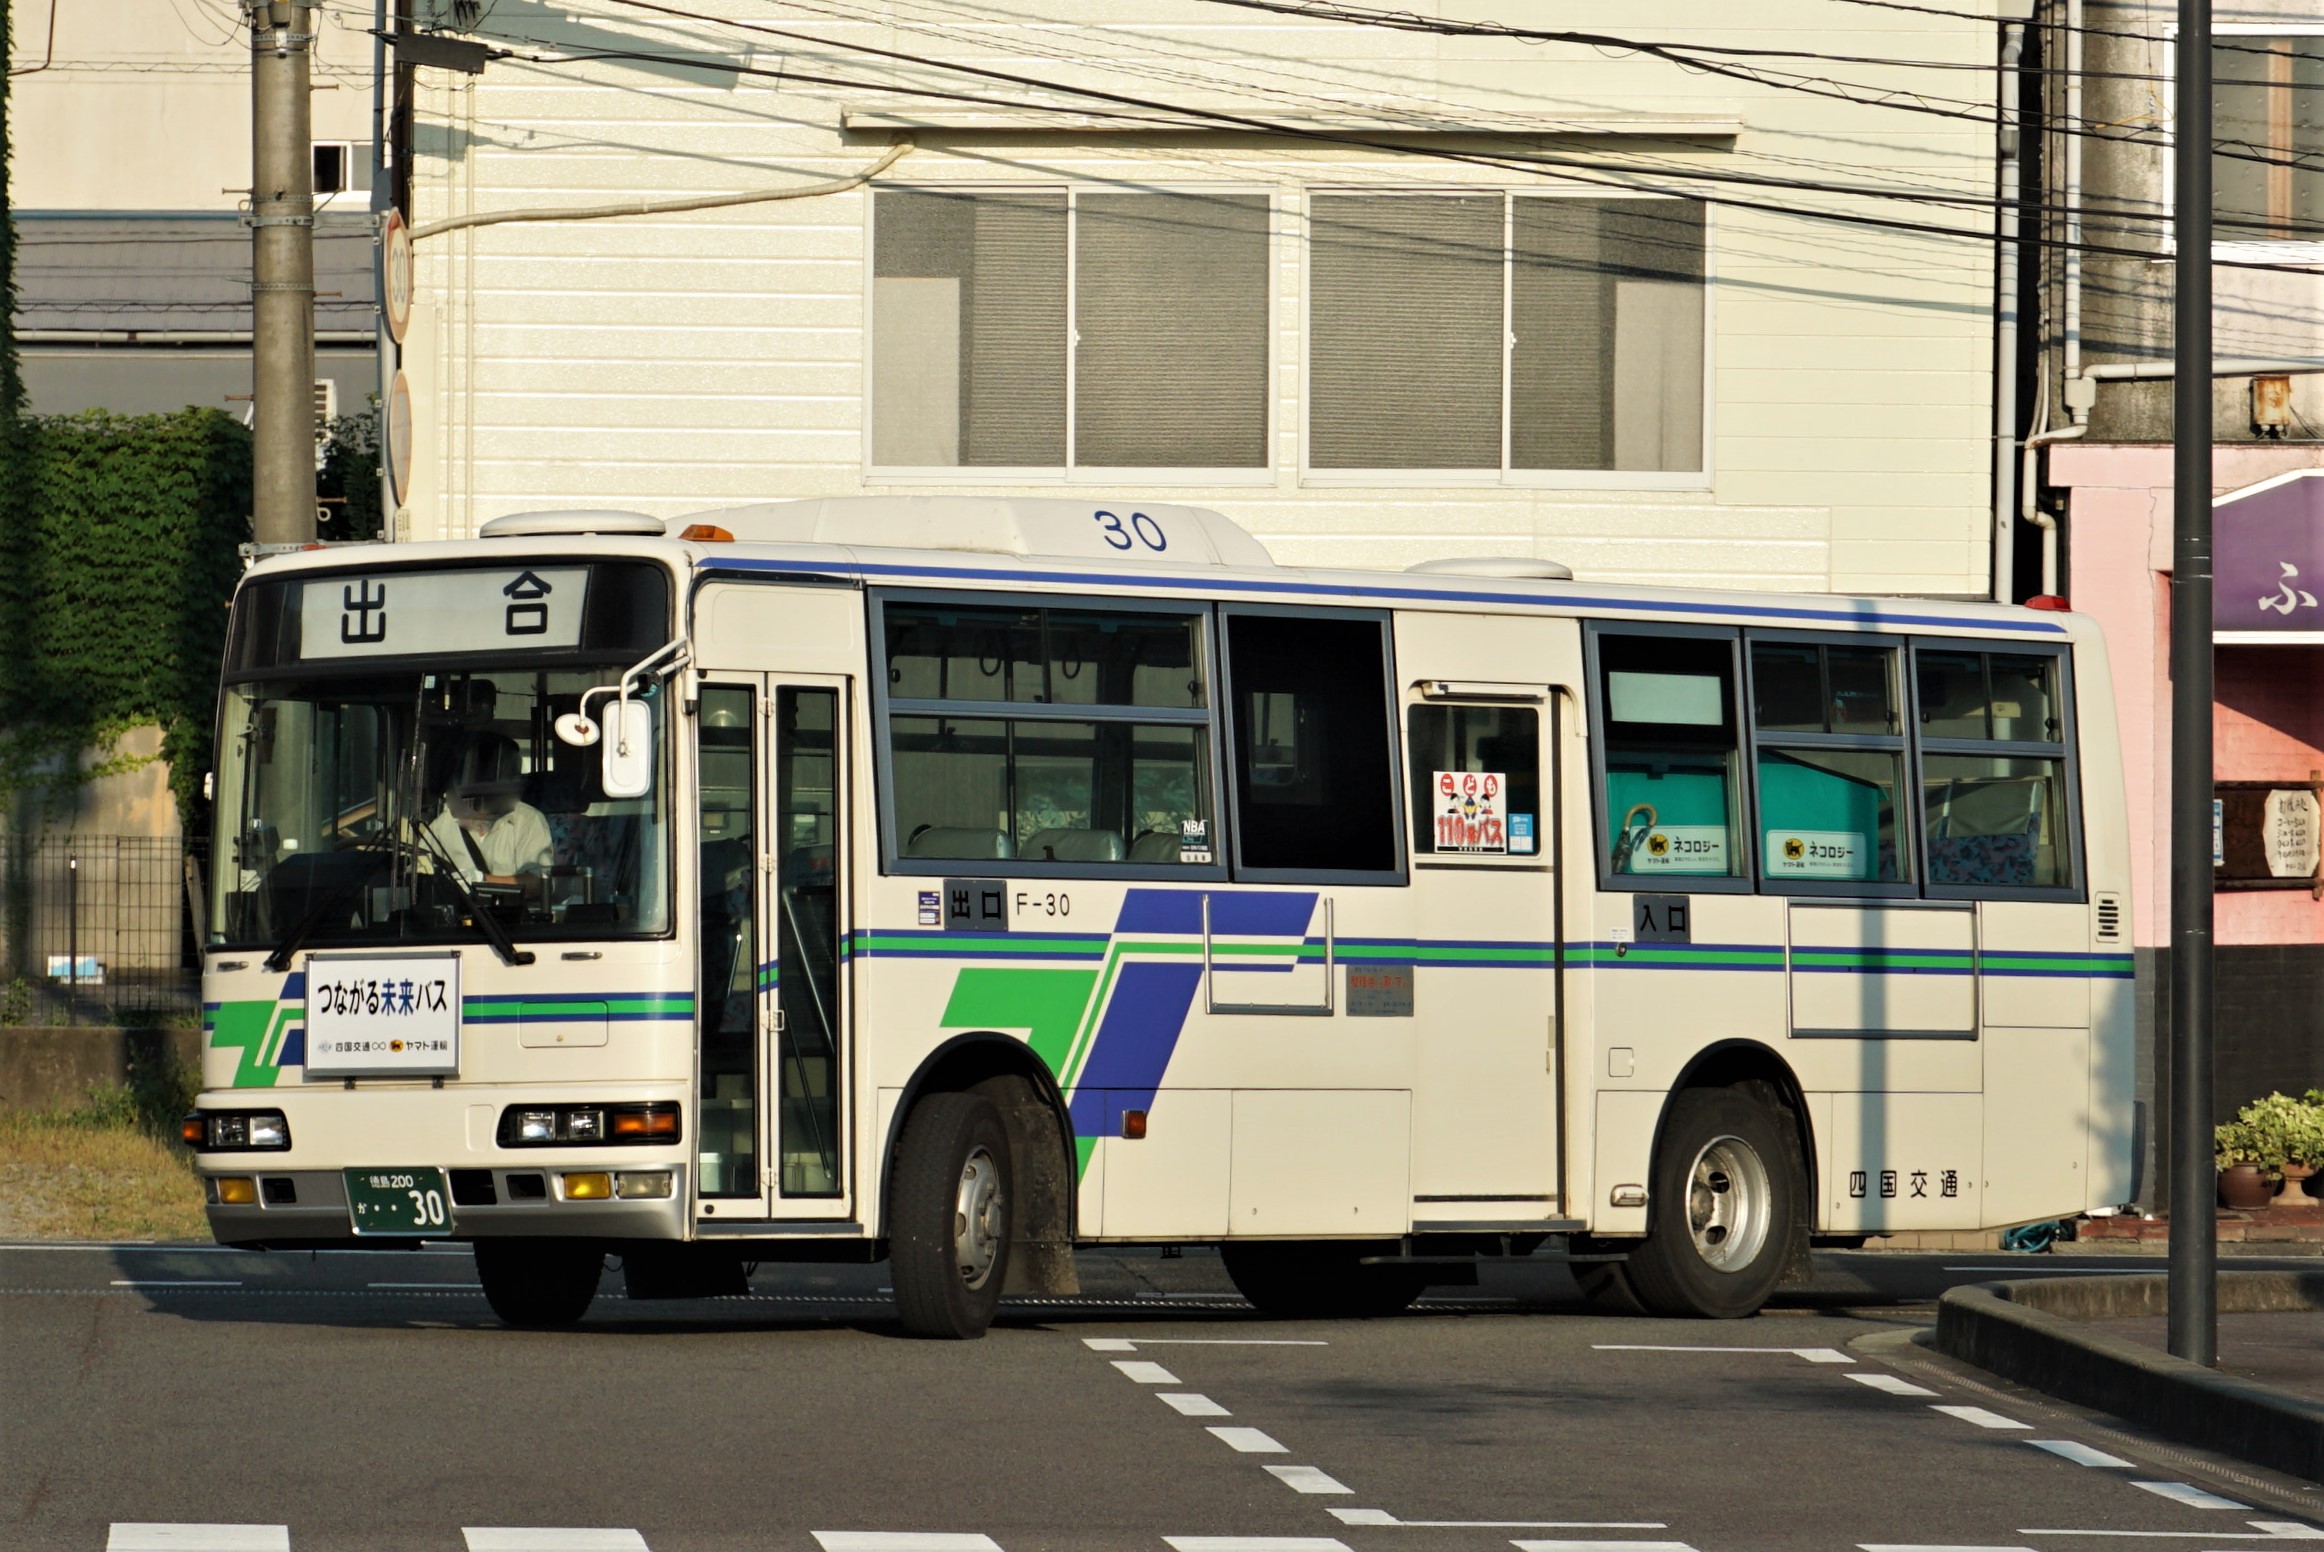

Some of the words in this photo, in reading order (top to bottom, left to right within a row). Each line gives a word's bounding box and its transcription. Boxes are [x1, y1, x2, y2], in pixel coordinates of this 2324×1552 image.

[391, 247, 406, 304] 30
[1093, 510, 1167, 552] 30
[2258, 561, 2318, 615] ふ
[1441, 775, 1498, 796] こども
[1182, 819, 1208, 833] NBA
[1673, 836, 1720, 853] ネコロジー
[1809, 841, 1854, 859] ネコロジー
[951, 889, 1001, 920] 出口
[1016, 892, 1071, 917] F-30
[1639, 904, 1686, 933] 入口
[318, 978, 447, 1017] つながる未来バス
[1849, 1168, 1958, 1199] 四国交通
